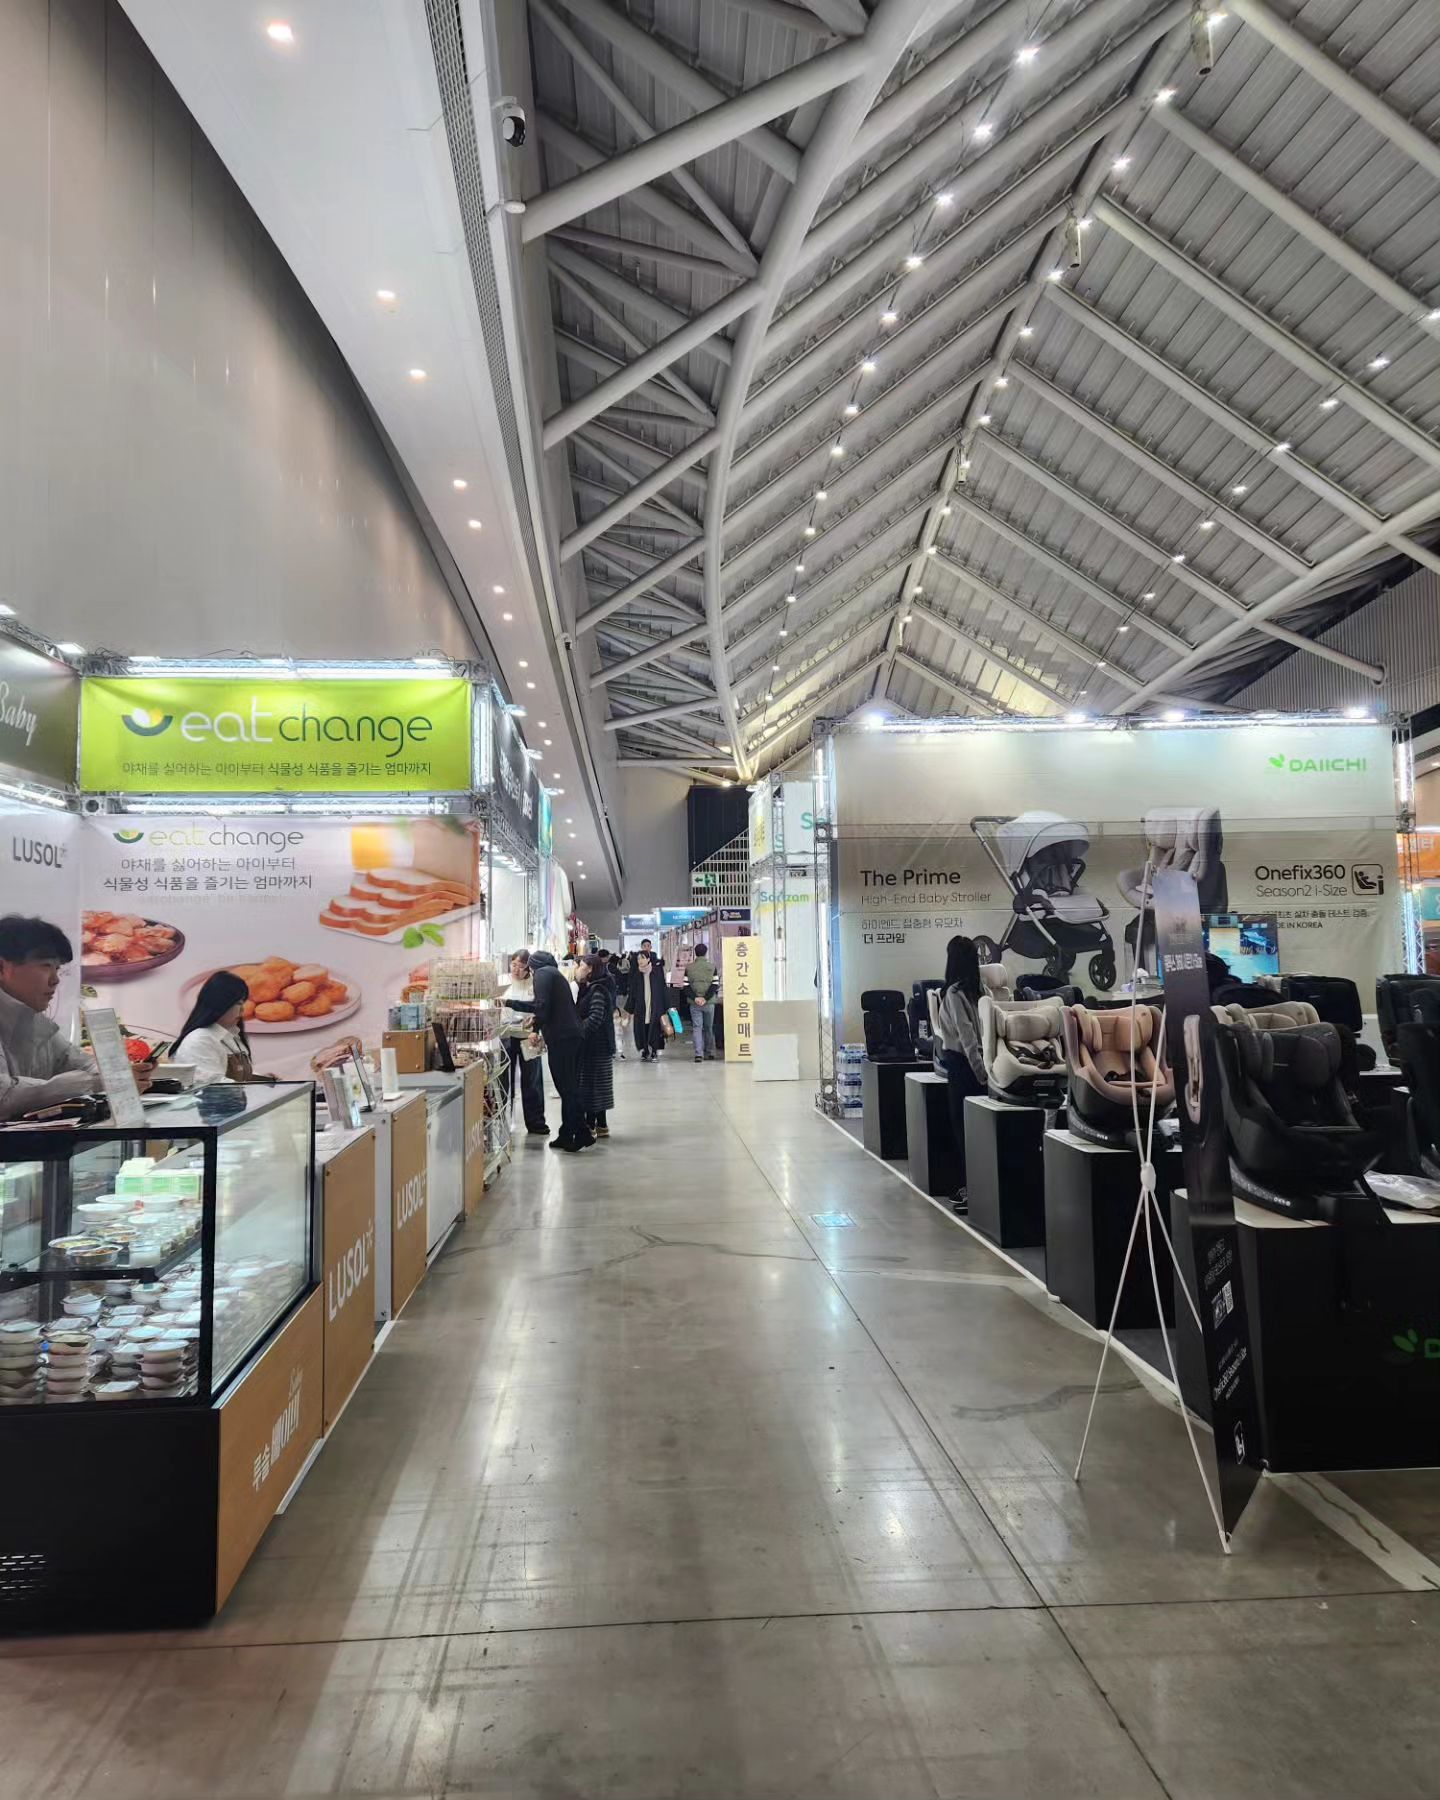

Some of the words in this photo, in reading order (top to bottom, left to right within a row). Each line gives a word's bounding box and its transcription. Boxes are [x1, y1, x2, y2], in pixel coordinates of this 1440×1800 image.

[122, 762, 158, 776] 야채를
[215, 762, 264, 776] 아이부터
[268, 762, 303, 776] 식물성
[307, 762, 342, 776] 식품을
[346, 762, 382, 775] 즐기는
[385, 762, 431, 775] 엄마까지
[1289, 759, 1366, 772] DAIICHI
[12, 836, 62, 868] LUSOL
[121, 858, 166, 873] 야채를
[172, 858, 231, 872] 싫어하는
[236, 857, 295, 871] 아이부터
[1255, 864, 1345, 880] Onefix360
[103, 876, 149, 891] 식물성
[153, 876, 198, 891] 식품을
[203, 876, 248, 890] 즐기는
[253, 875, 312, 889] 엄마까지
[860, 870, 897, 886] The
[903, 869, 961, 885] Prime
[1256, 884, 1312, 897] Season2
[1315, 884, 1348, 896] i-Size
[861, 893, 916, 906] High-End
[919, 893, 948, 905] Baby
[951, 892, 991, 903] Stroller
[1328, 909, 1351, 918] 테스트
[862, 919, 901, 929] 하이엔드
[1296, 920, 1323, 929] KOREA
[396, 1174, 424, 1230] LUSOL
[329, 1231, 369, 1322] LUSOL
